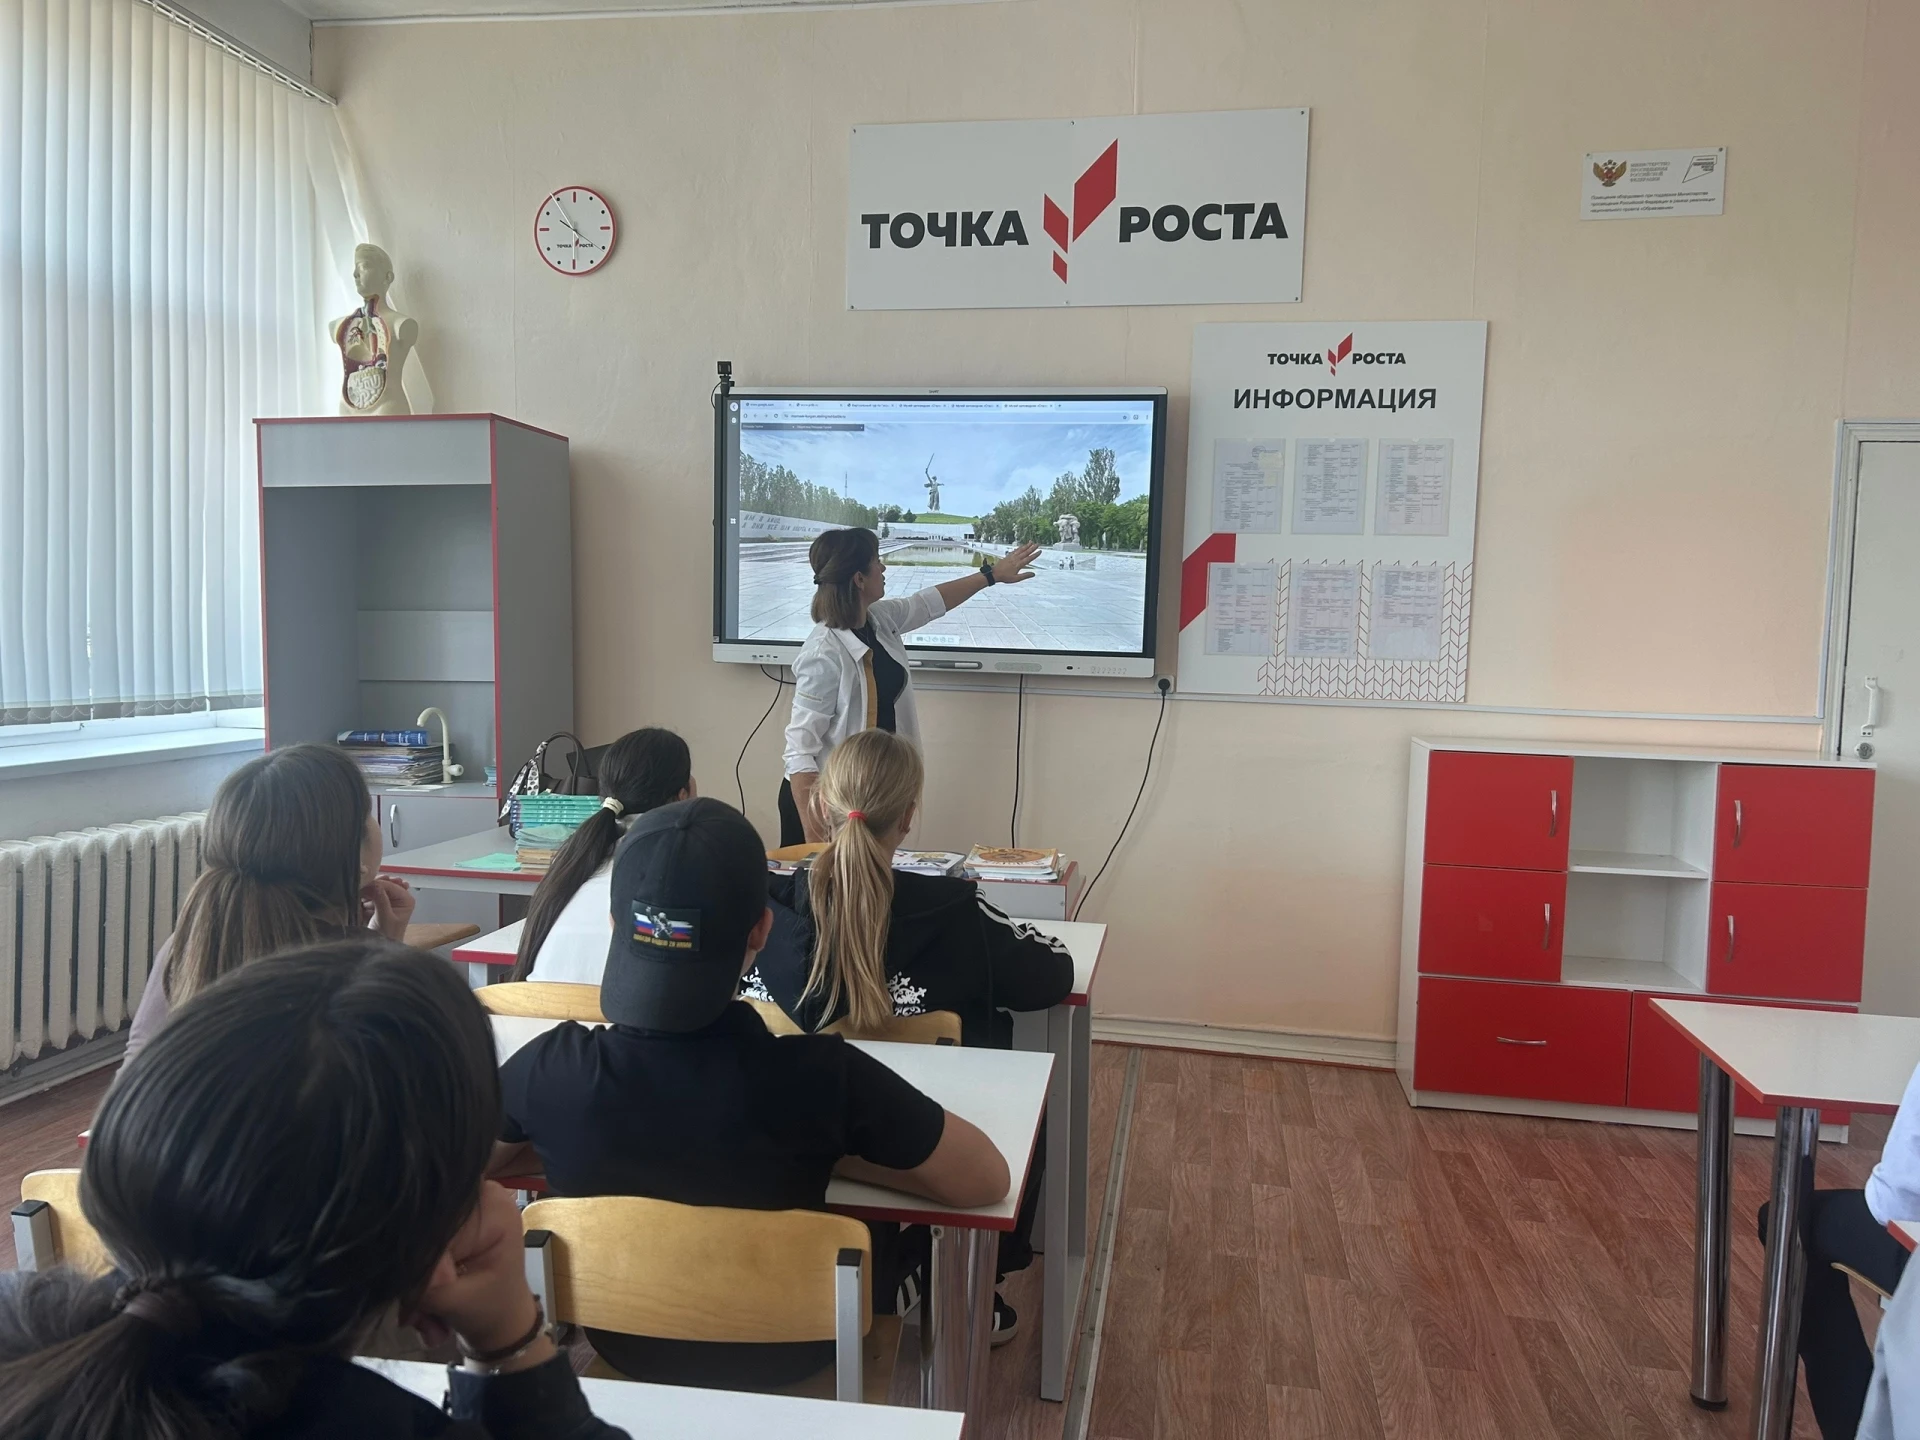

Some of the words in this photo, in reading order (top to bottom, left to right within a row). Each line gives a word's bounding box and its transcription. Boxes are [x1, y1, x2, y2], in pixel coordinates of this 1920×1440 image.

[861, 210, 1030, 249] ТОЧКА
[1119, 202, 1289, 243] РОСТА
[1267, 351, 1323, 366] ТОЧКА
[1352, 351, 1406, 365] РОСТА
[1233, 387, 1437, 413] ИНФОРМАЦИЯ
